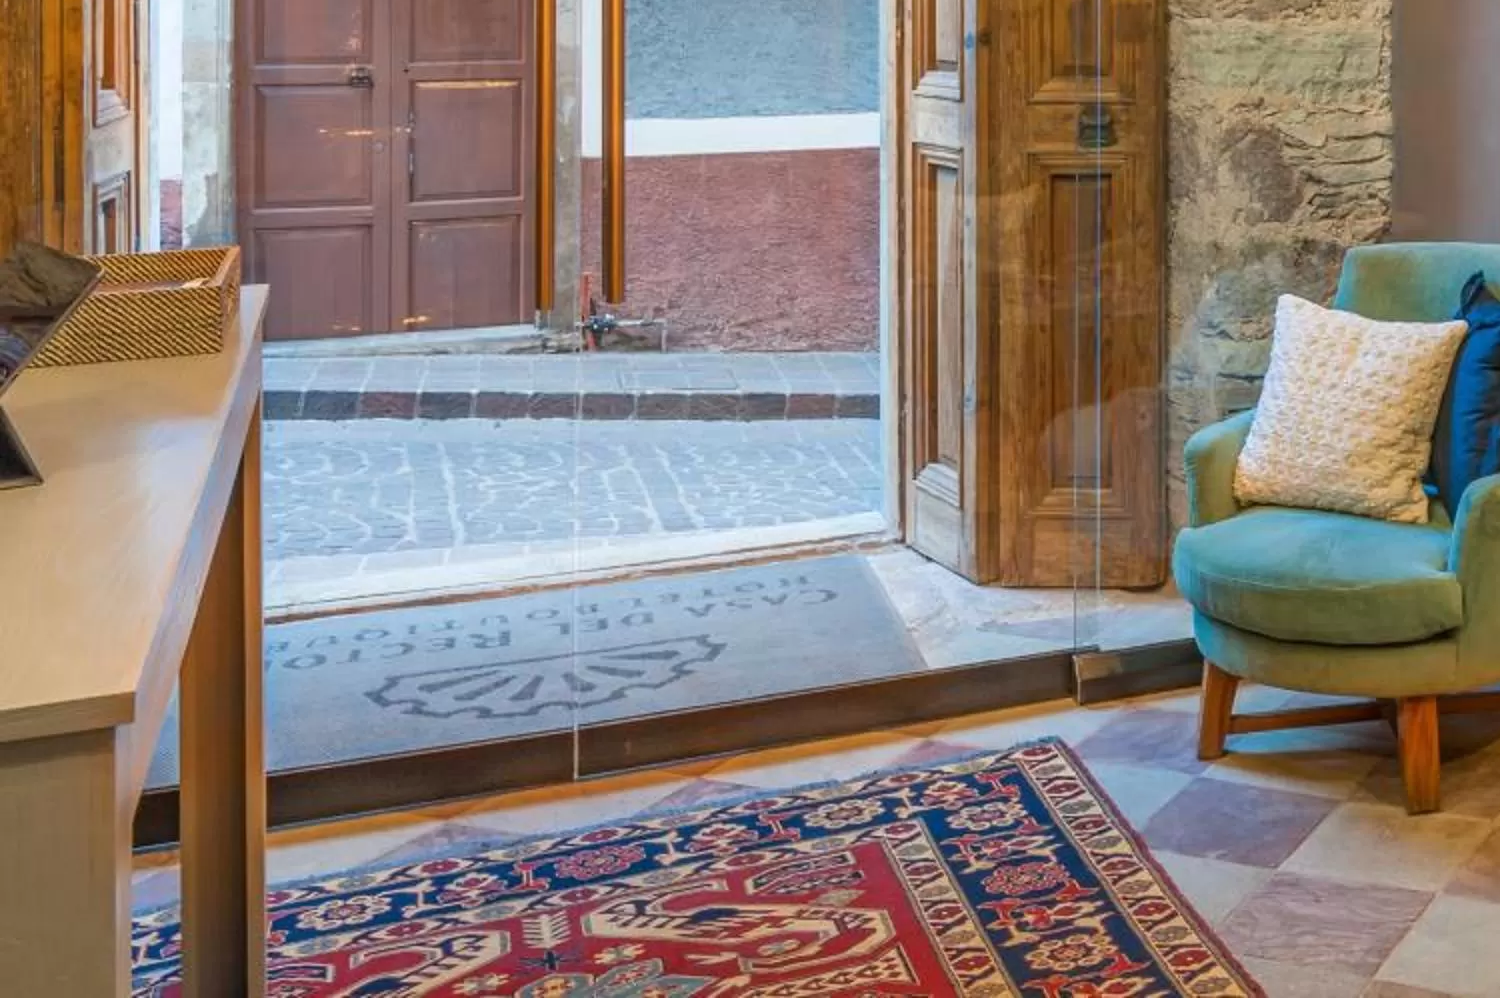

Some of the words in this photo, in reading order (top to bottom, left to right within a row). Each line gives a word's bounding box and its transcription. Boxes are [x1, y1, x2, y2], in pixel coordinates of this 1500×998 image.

[622, 574, 809, 608] HOTEL
[684, 588, 838, 618] CASA
[549, 610, 654, 636] DEL
